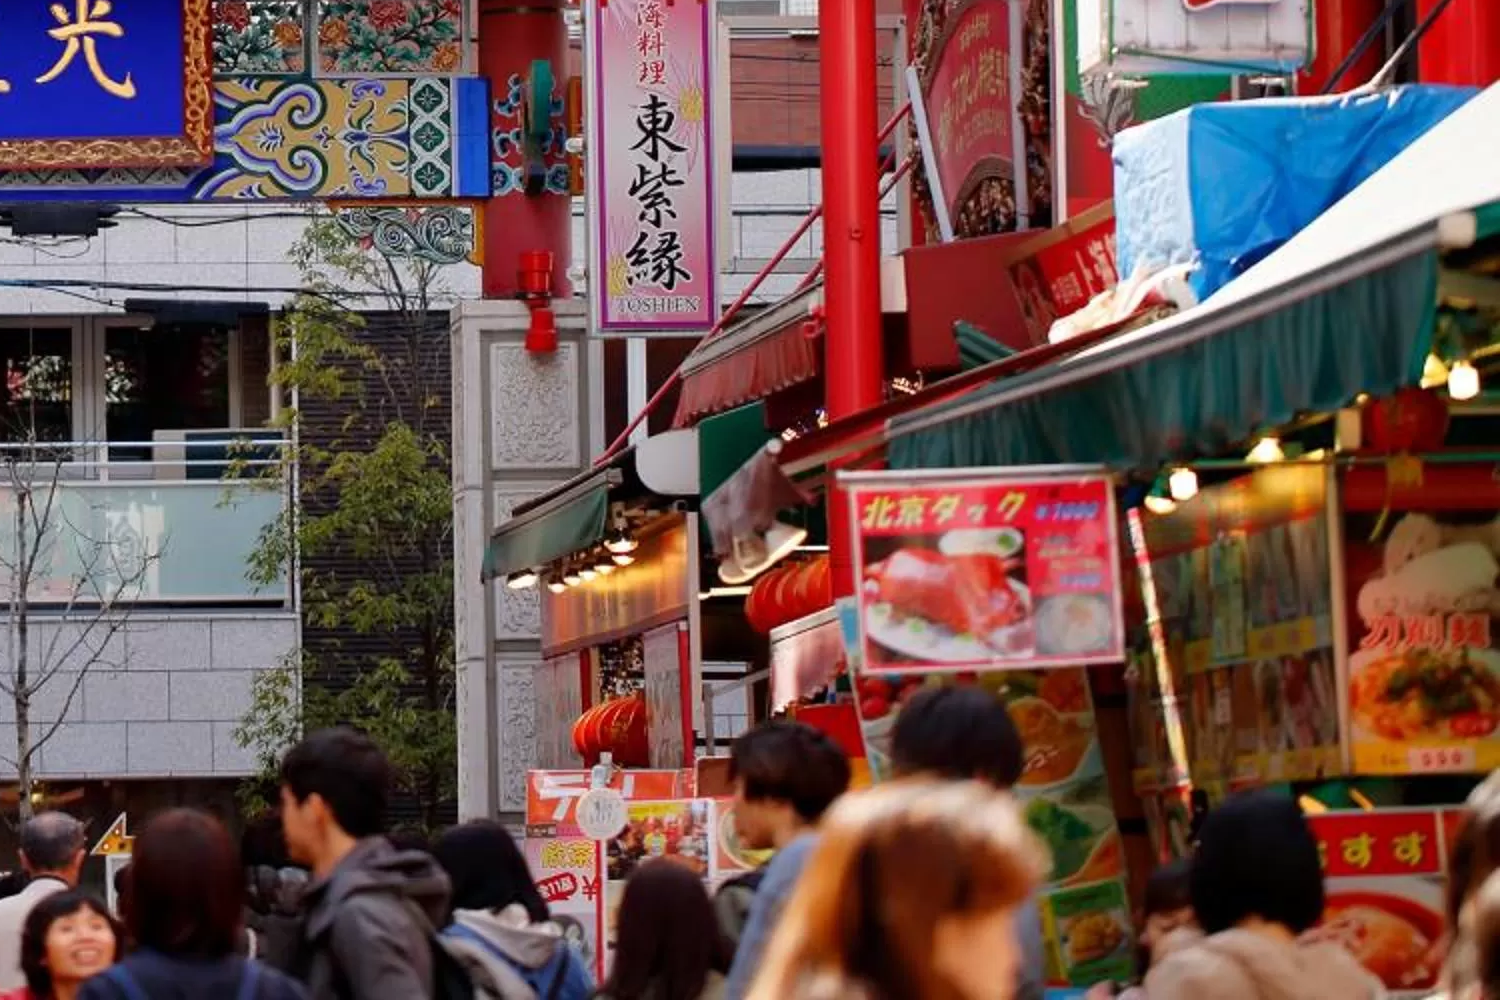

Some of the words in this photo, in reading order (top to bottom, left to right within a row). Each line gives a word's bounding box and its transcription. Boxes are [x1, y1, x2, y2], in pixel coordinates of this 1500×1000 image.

[625, 95, 691, 290] 東紫縁
[862, 491, 1027, 529] 北京ダック
[1318, 831, 1428, 869] すす
